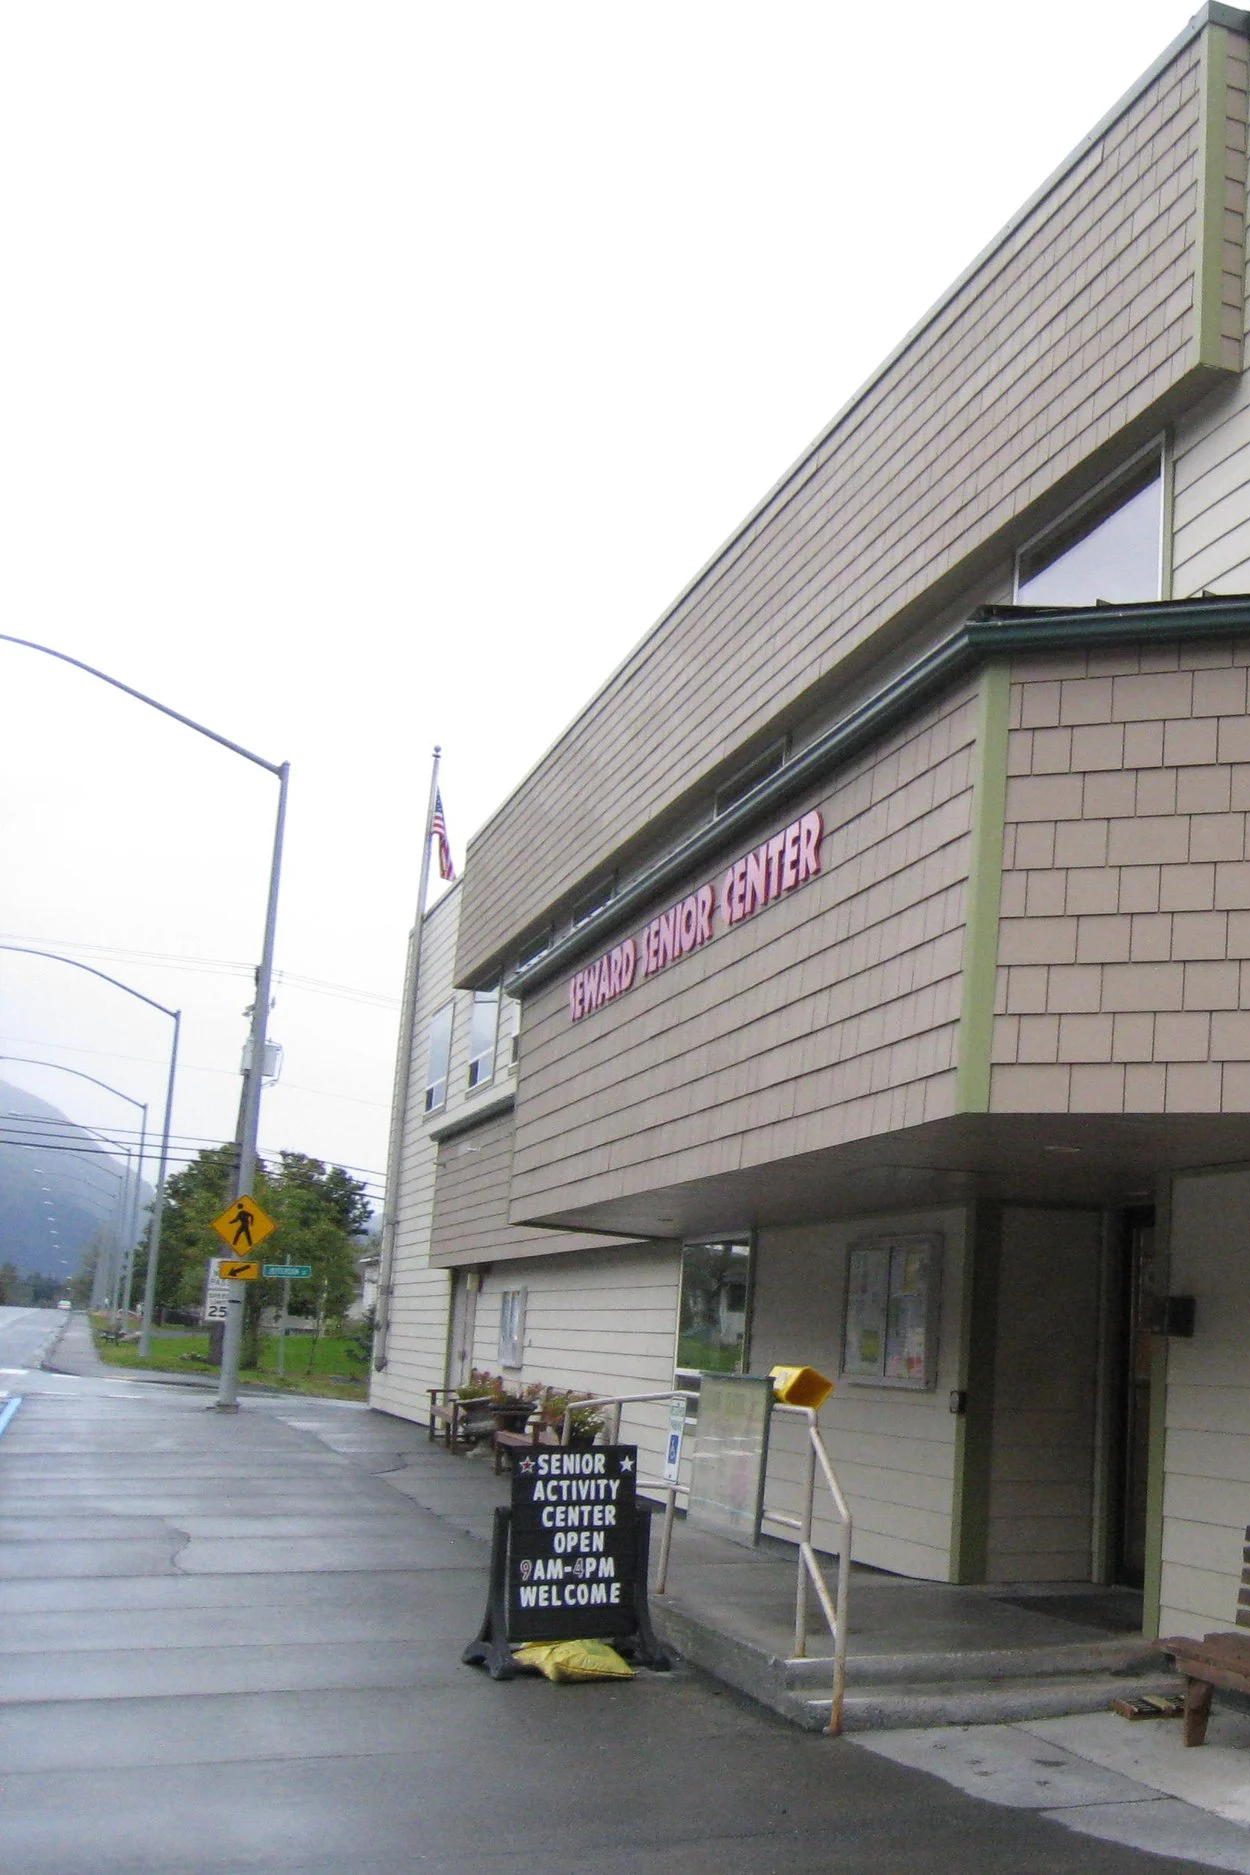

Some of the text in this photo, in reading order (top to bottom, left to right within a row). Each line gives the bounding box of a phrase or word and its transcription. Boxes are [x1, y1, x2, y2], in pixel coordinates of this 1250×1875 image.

[642, 884, 715, 977] SENIOR
[720, 810, 824, 926] CENTER
[207, 1305, 227, 1318] 25
[537, 1453, 606, 1476] SENIOR
[532, 1479, 620, 1502] ACTIVITY
[541, 1504, 616, 1528] CENTER
[553, 1531, 605, 1554] OPEN
[520, 1556, 615, 1581] 9AM-4PM
[519, 1582, 621, 1608] WELCOME
